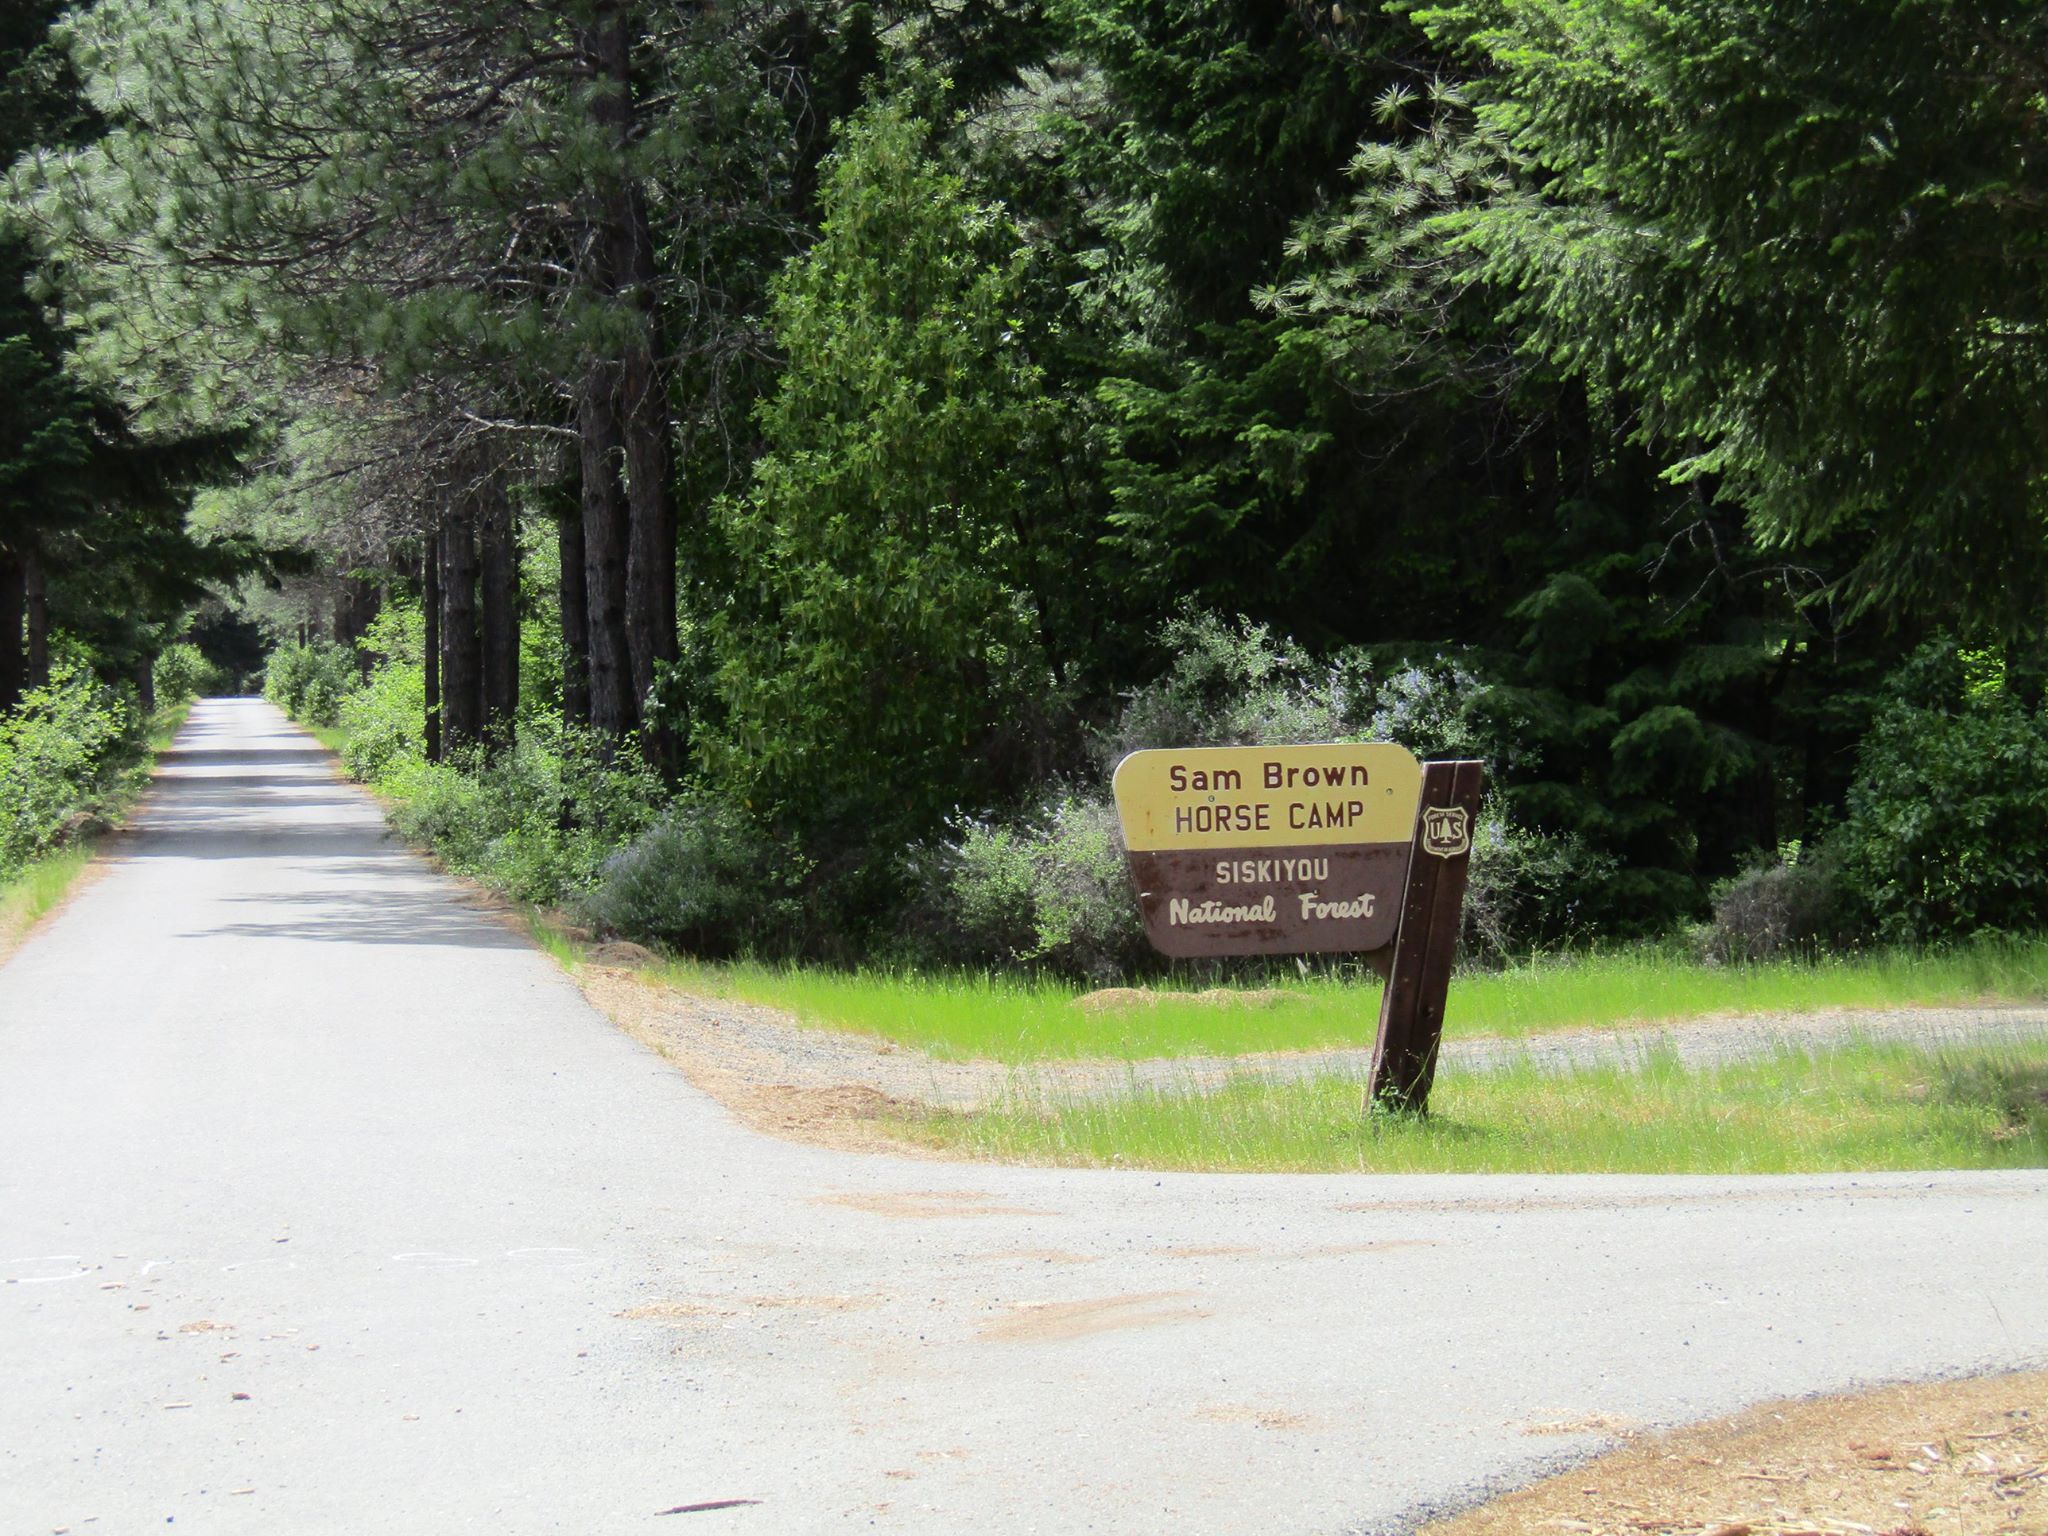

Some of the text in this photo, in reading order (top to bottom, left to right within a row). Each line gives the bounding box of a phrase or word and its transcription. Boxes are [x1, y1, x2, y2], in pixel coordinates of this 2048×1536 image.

[1169, 762, 1369, 792] Sam Brown
[1175, 801, 1364, 833] HORSE CAMP
[1216, 858, 1329, 884] SISKIYOU
[1169, 892, 1375, 925] National Forest
